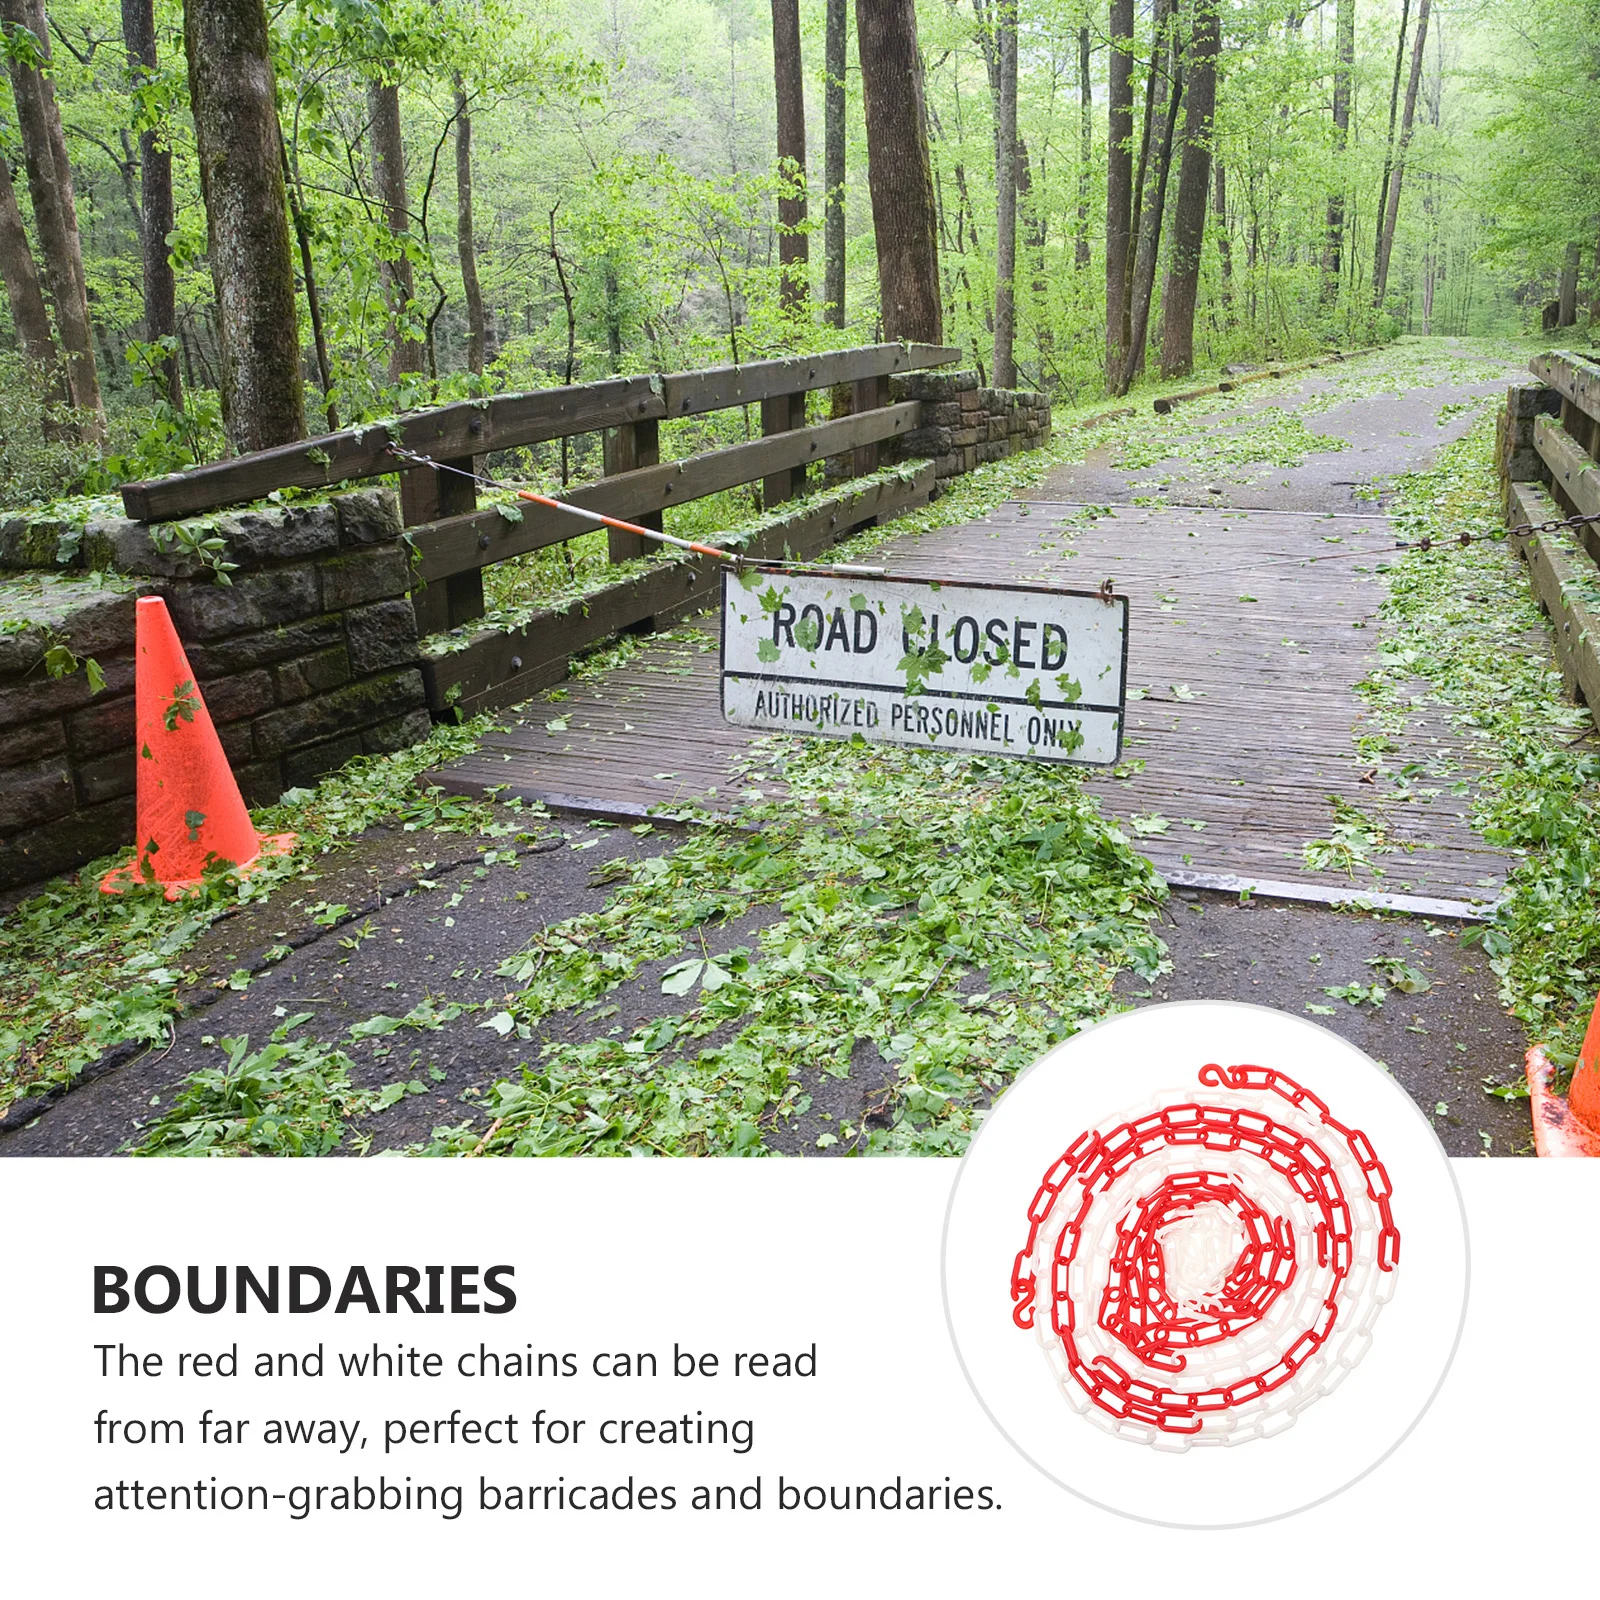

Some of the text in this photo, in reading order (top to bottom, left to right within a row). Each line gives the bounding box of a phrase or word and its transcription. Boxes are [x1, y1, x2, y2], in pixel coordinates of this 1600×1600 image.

[773, 602, 878, 654] ROAD
[754, 690, 879, 728] AUTHORIZED
[891, 704, 1014, 743] PERSONNEL
